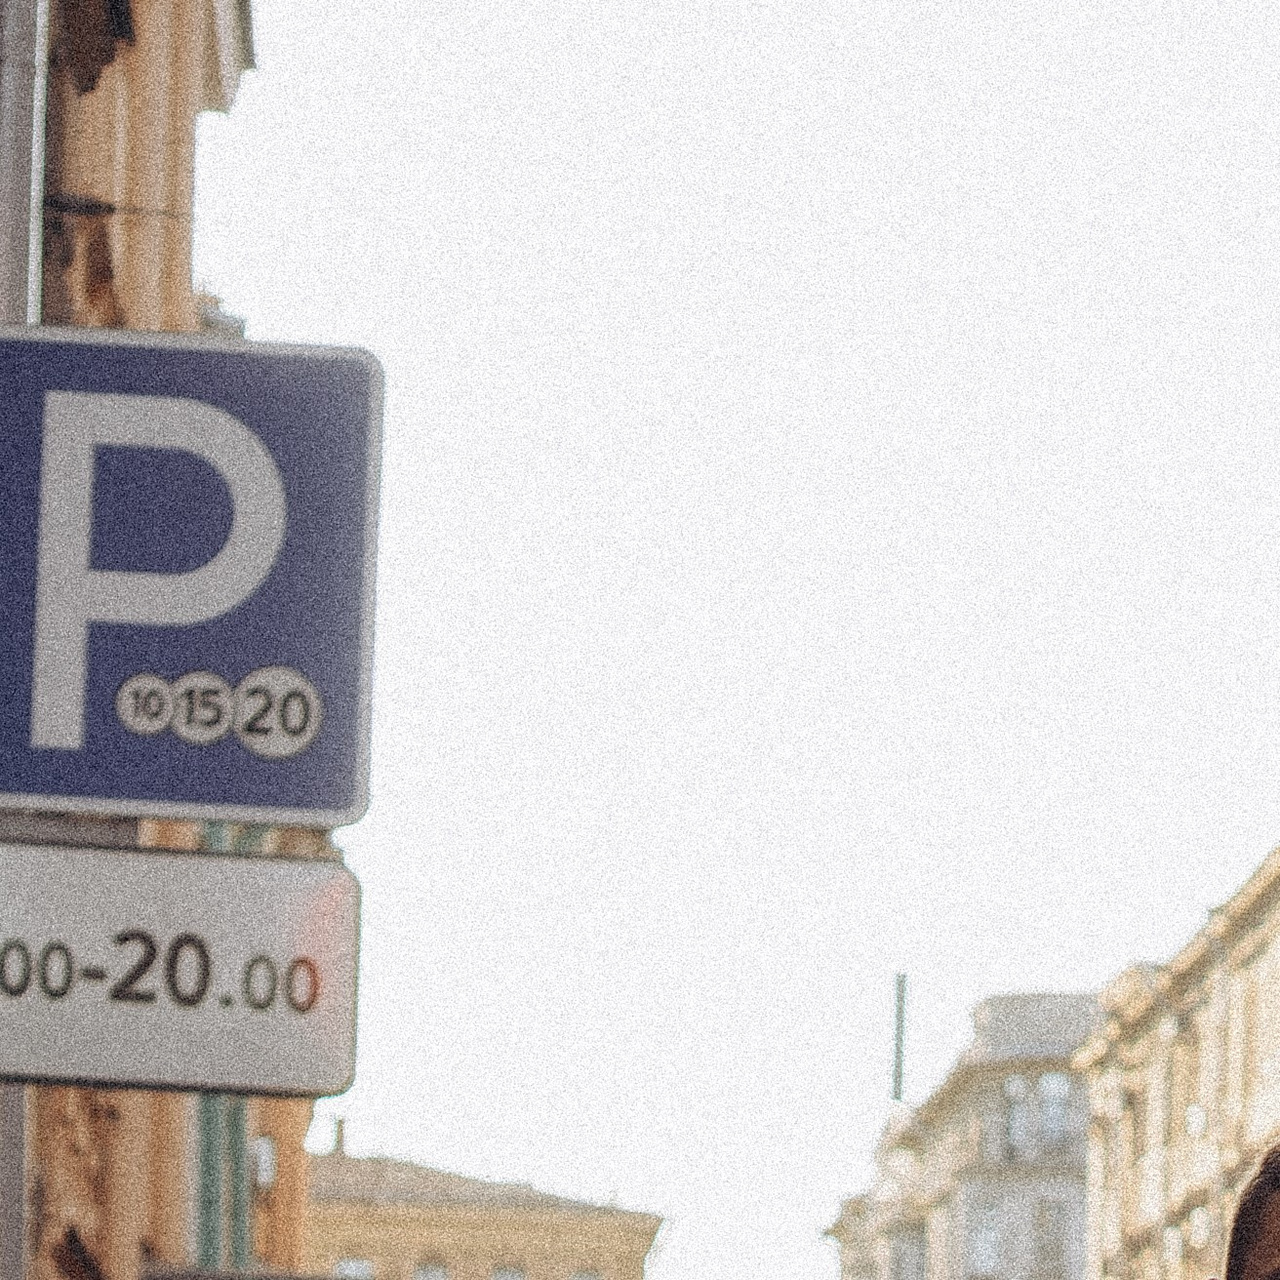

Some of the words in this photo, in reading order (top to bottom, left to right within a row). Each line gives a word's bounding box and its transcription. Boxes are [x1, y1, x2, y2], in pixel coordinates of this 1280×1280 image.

[29, 389, 287, 751] P
[131, 688, 164, 720] 10
[183, 688, 224, 728] 15
[243, 686, 310, 738] 20
